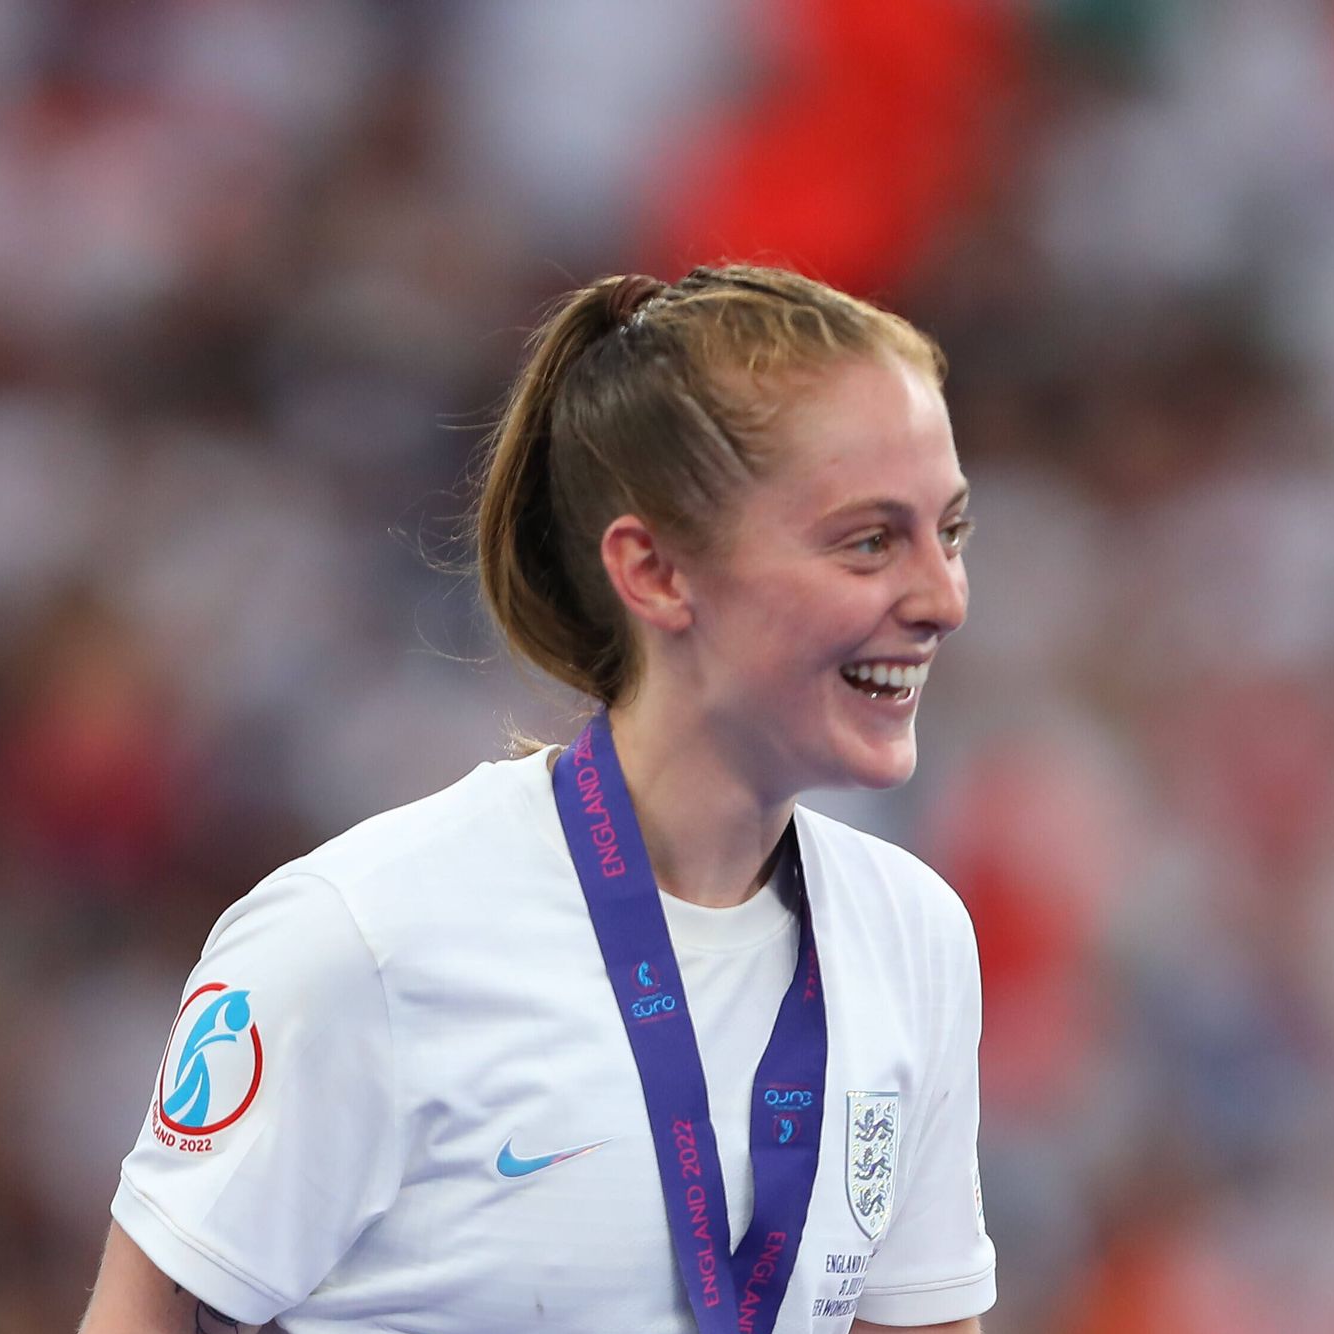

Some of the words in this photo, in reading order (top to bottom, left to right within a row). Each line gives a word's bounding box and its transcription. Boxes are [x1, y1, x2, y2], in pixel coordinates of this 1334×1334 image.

[577, 766, 626, 879] ENGLAND
[179, 1138, 213, 1152] 2022
[674, 1118, 702, 1180] 2022
[685, 1184, 721, 1308] ENGLAND
[826, 1253, 861, 1274] ENGLAND
